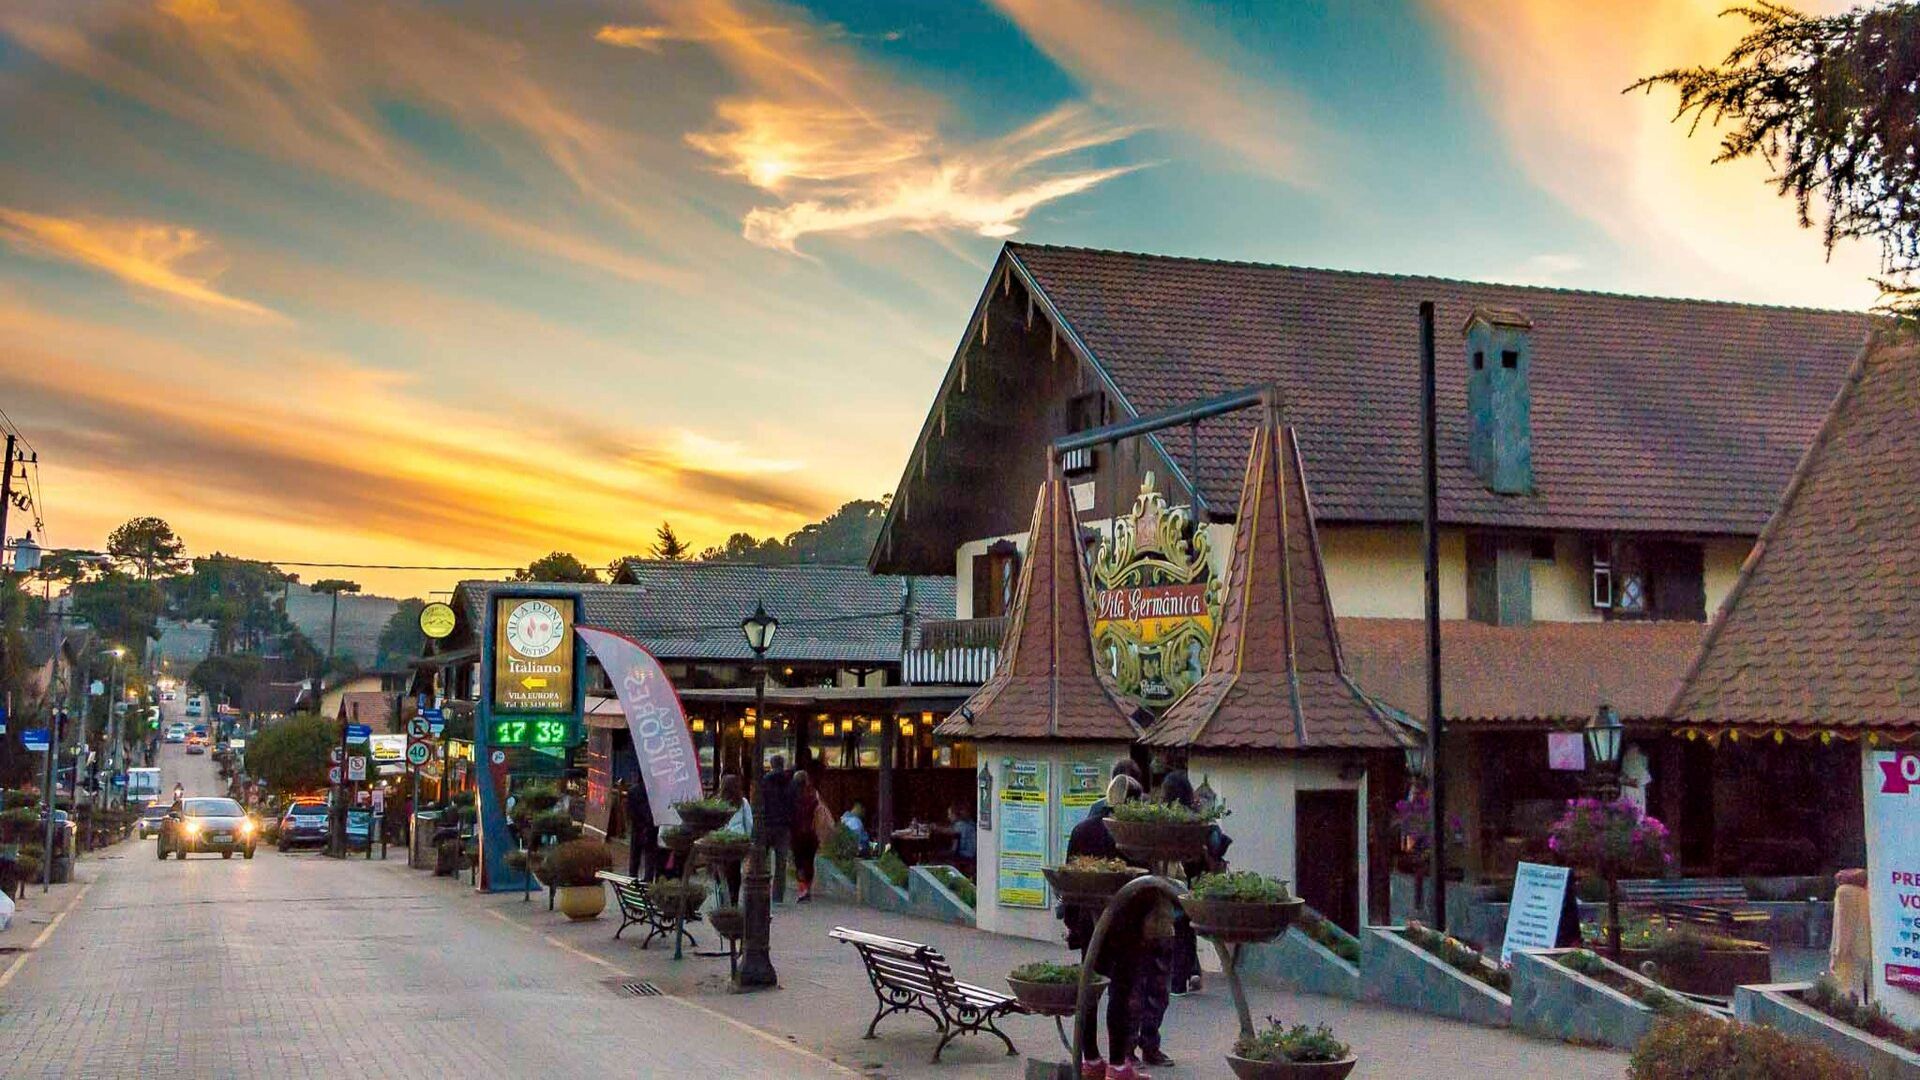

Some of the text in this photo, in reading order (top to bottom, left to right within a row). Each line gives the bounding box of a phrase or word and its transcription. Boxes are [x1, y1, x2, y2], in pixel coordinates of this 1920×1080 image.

[1098, 588, 1201, 622] Vila Germânica
[533, 602, 563, 640] DONNA
[509, 661, 562, 674] Italiano
[508, 692, 560, 700] VILA EUROPA
[498, 721, 565, 743] 17 39
[409, 746, 426, 757] 40
